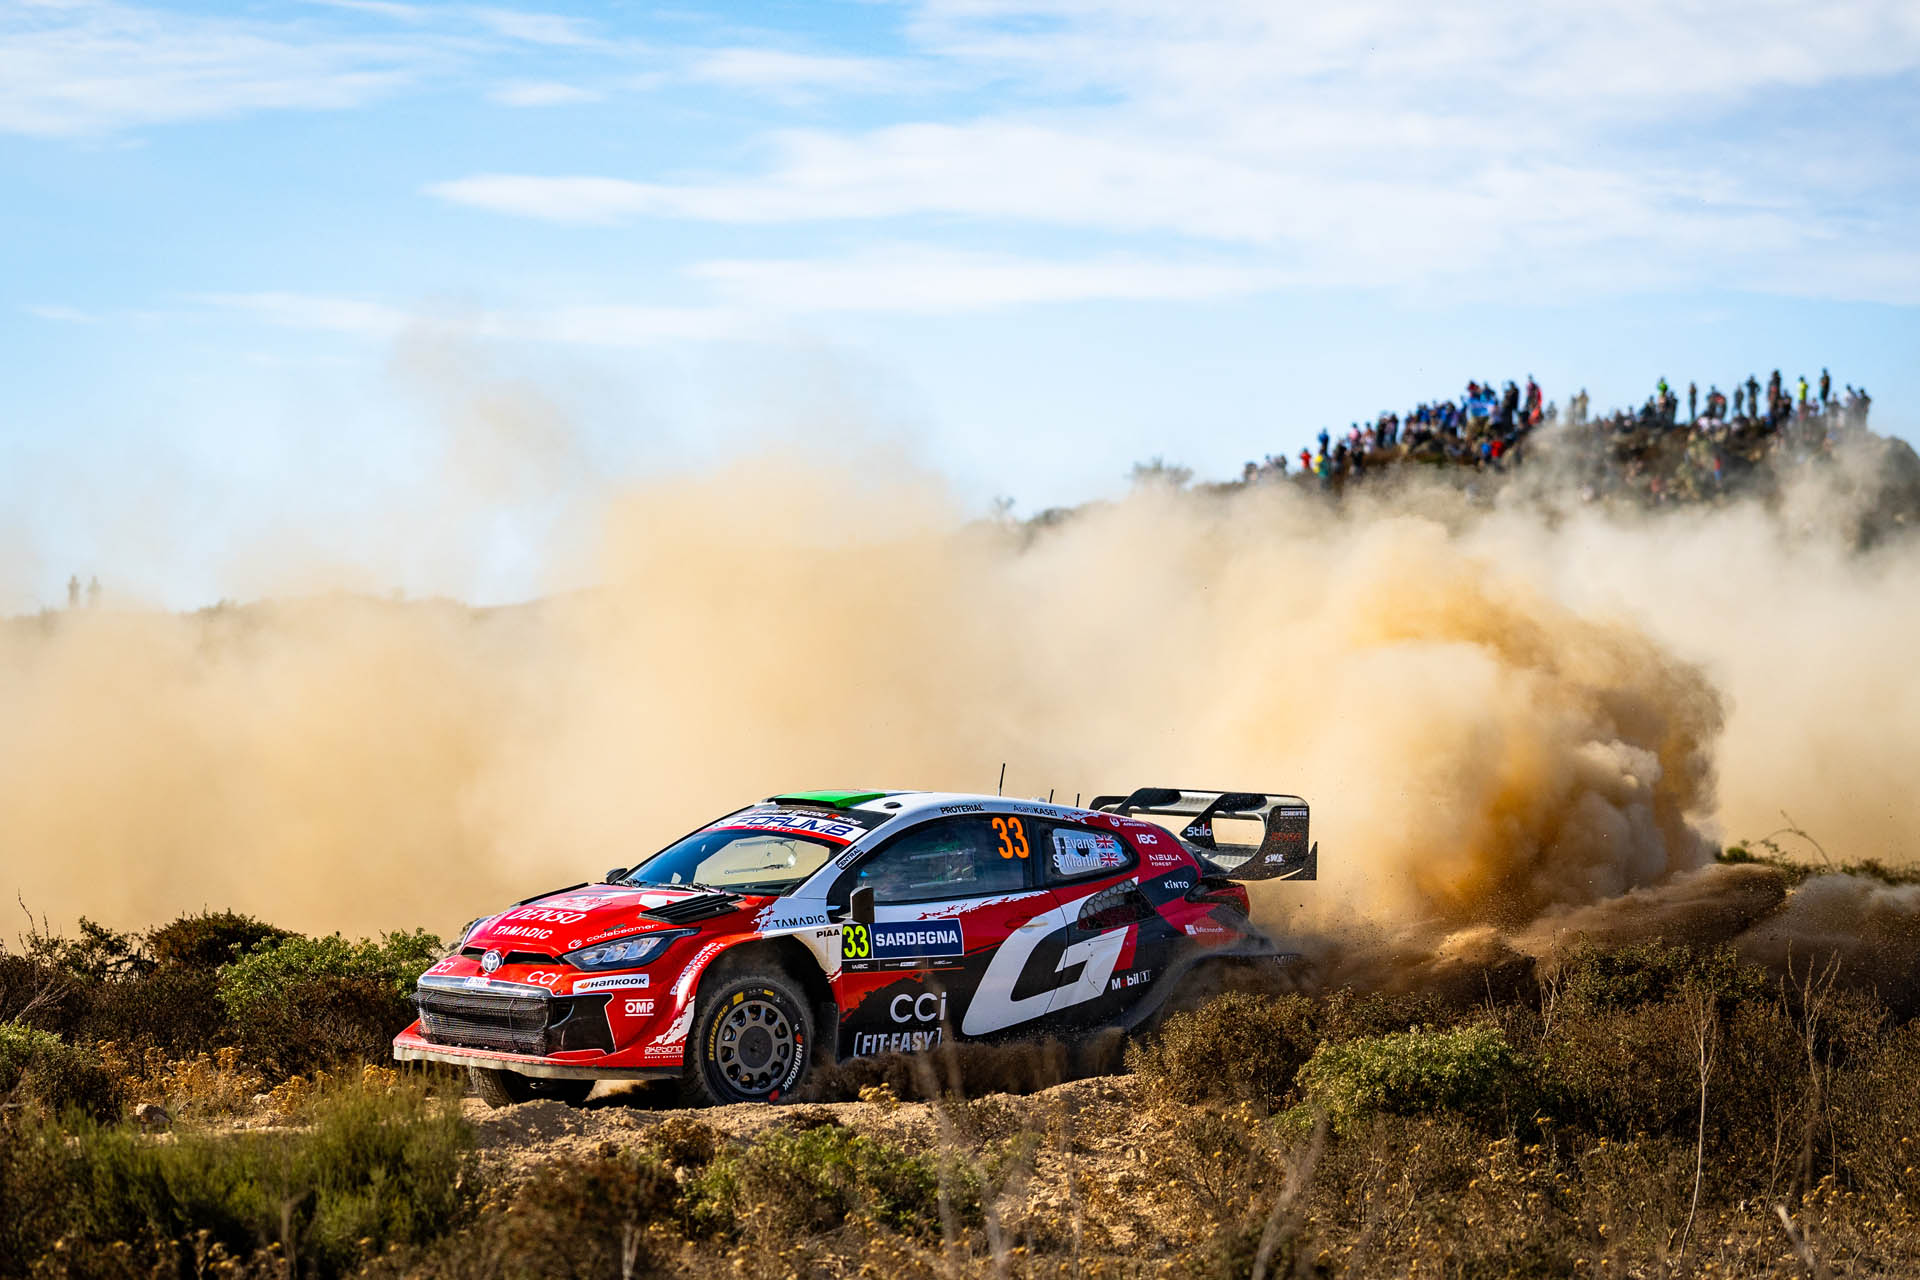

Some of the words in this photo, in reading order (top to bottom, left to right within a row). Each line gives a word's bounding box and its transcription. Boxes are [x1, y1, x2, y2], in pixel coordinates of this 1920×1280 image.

[940, 804, 985, 814] PROTERIAL
[731, 816, 854, 837] FORUM8
[1186, 821, 1212, 837] Stilo
[992, 816, 1030, 859] 33
[505, 908, 588, 925] DENSO
[771, 914, 826, 928] TAMADIC
[491, 925, 554, 940] TAMADIC
[586, 922, 656, 943] codebeamer
[816, 930, 840, 939] PIAA
[875, 929, 959, 947] SARDEGNA
[841, 924, 870, 959] 33
[1112, 972, 1140, 990] Mobil
[625, 1002, 655, 1014] OMP
